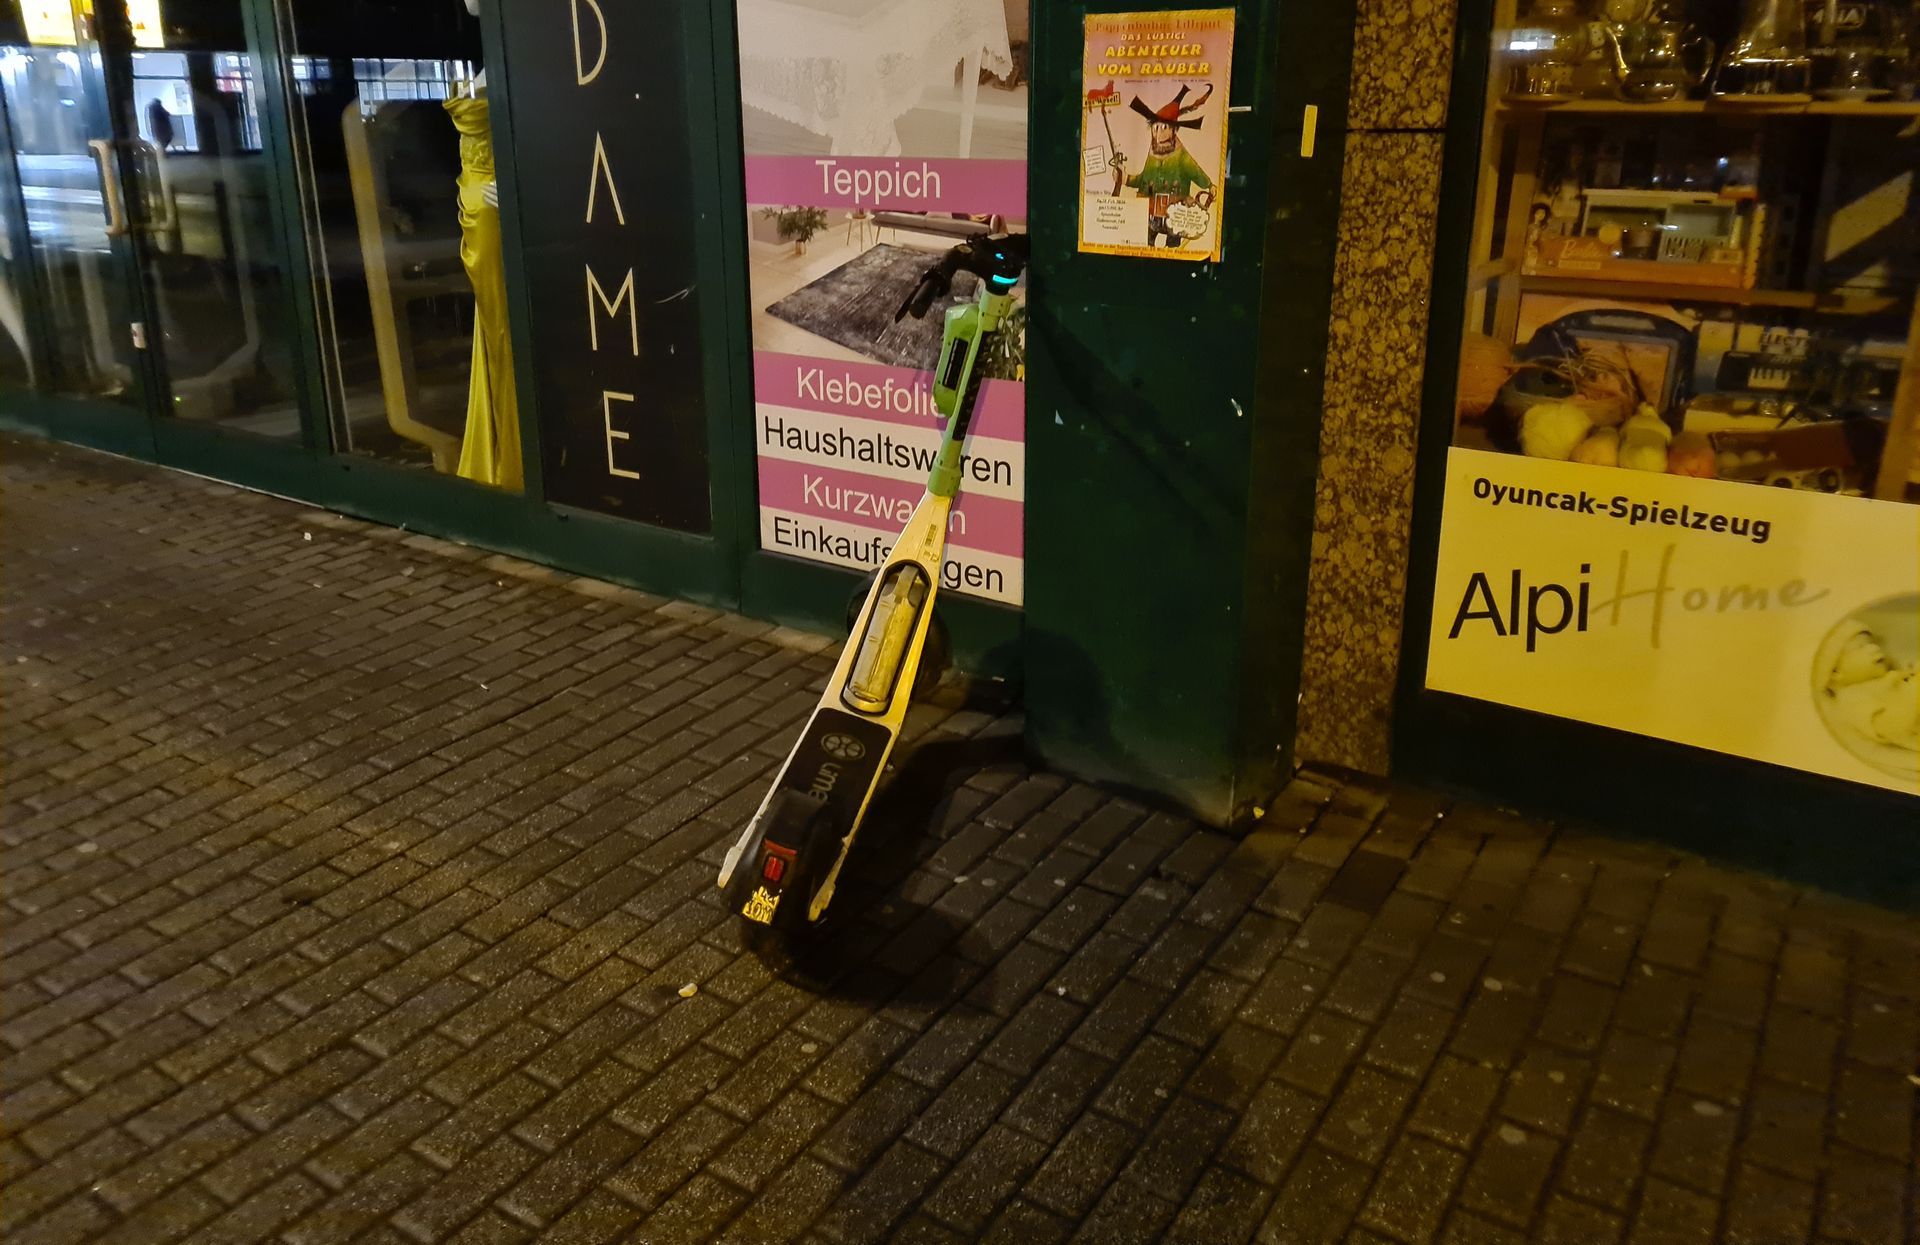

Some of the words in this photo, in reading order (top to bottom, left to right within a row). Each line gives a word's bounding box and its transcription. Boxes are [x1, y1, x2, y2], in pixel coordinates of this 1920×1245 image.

[1105, 43, 1202, 58] ABENTEUER
[1120, 33, 1142, 41] DAS
[1147, 32, 1186, 41] LUSTIGE
[1097, 62, 1132, 75] VOM
[1140, 57, 1211, 75] RÄUBER
[816, 159, 942, 205] Teppich
[763, 415, 1012, 487] Haushaltswren
[802, 474, 967, 536] Kurzwan
[1472, 476, 1772, 544] Oyuncak-Spielzeug
[774, 517, 1004, 593] Einkaufsgen
